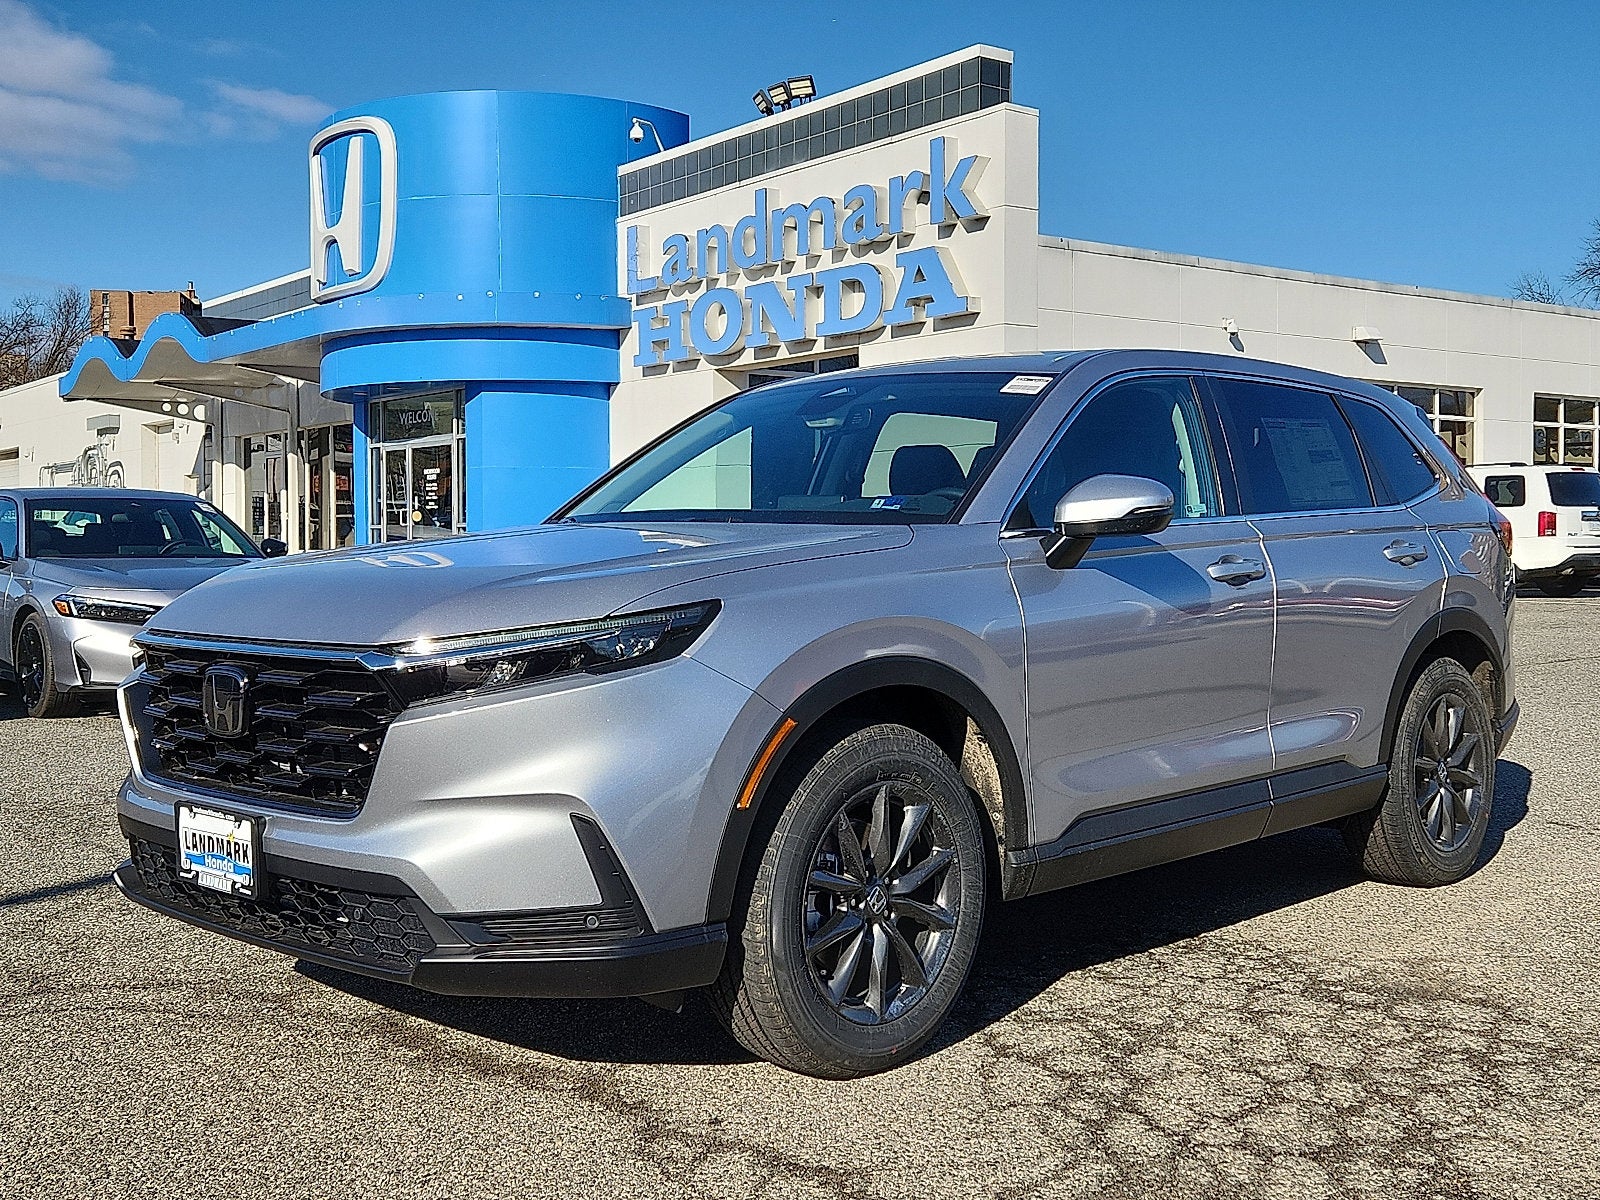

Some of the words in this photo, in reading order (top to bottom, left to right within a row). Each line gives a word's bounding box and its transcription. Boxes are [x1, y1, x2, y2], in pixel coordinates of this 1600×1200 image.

[626, 136, 990, 295] Landmark
[632, 246, 974, 368] HONDA
[184, 830, 250, 864] LANDMARK
[205, 854, 235, 872] Honda
